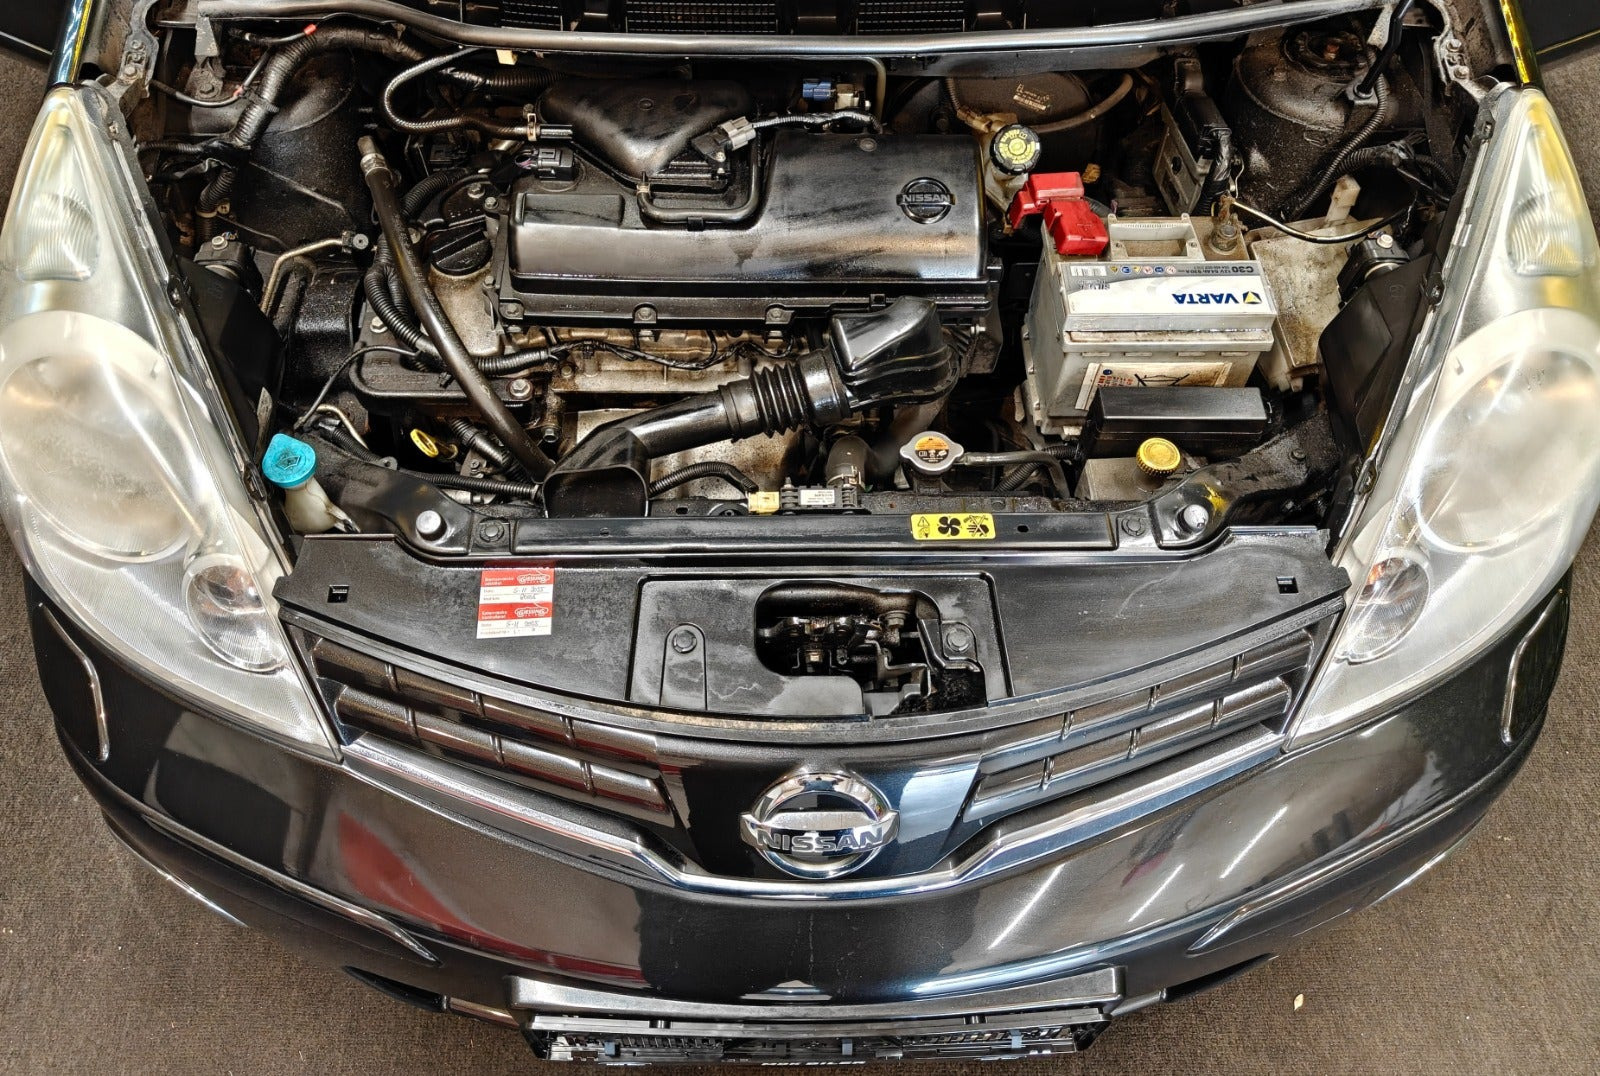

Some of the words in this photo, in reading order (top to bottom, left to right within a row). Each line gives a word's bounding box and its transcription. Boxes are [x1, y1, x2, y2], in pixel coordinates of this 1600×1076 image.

[902, 194, 951, 202] NISSAN
[1232, 265, 1254, 273] C30
[1172, 293, 1240, 305] VARTA
[757, 825, 883, 853] NISSAN
